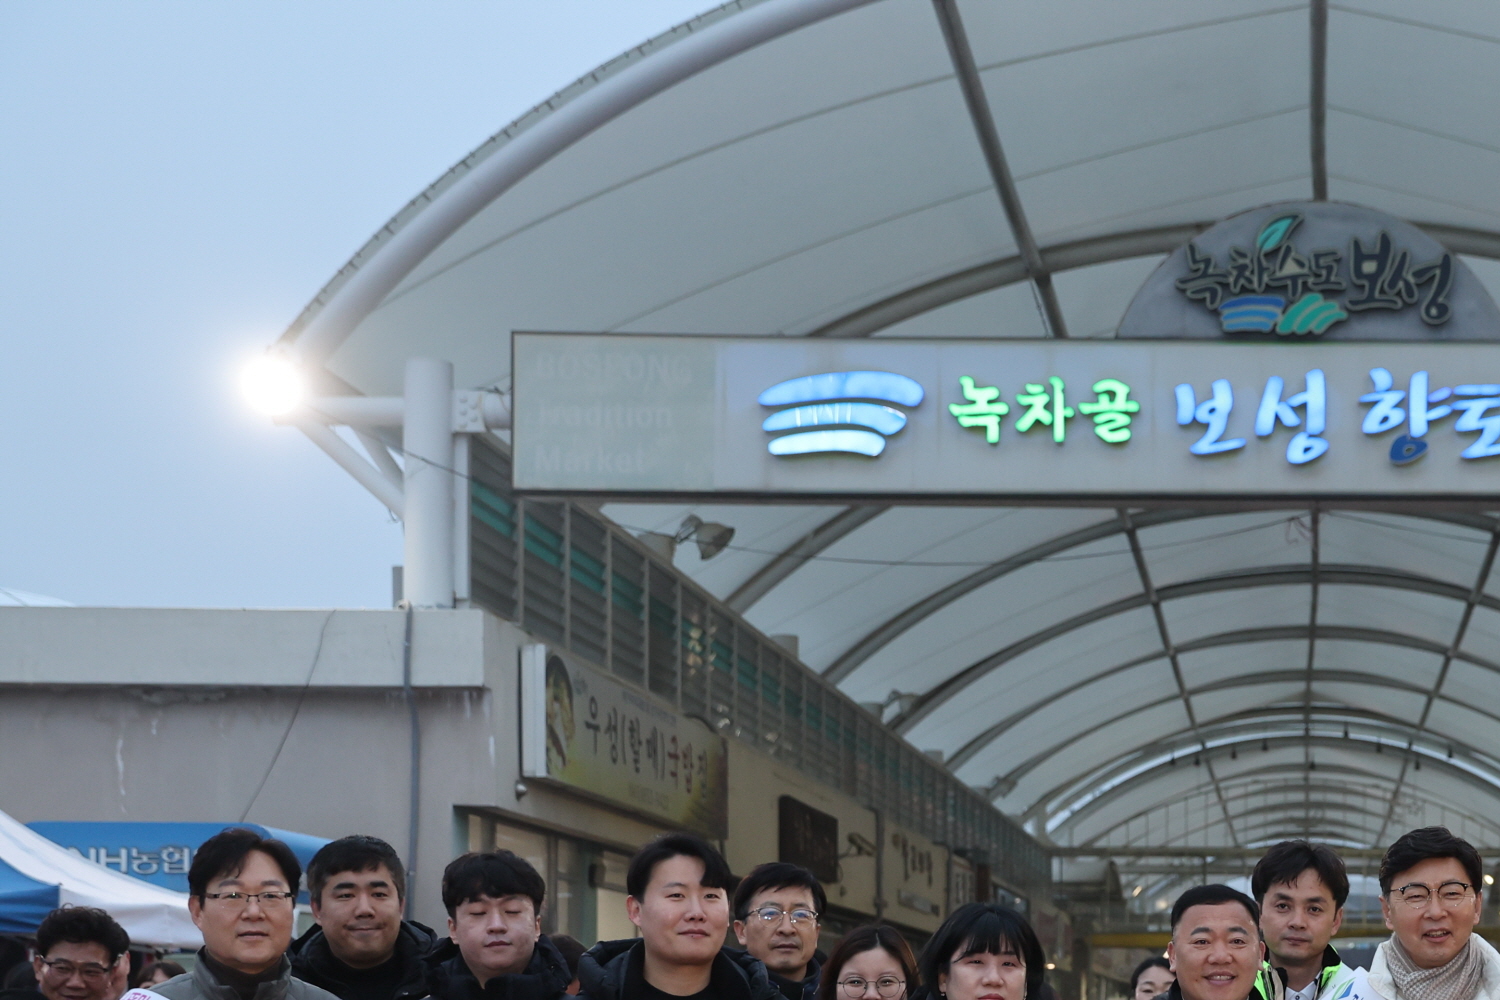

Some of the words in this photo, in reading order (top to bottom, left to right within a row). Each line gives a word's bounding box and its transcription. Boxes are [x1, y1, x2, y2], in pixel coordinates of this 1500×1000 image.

[1175, 243, 1347, 309] 녹차수도
[1345, 230, 1454, 325] 보성
[949, 375, 1142, 445] 녹차골
[1175, 369, 1331, 465] 보성
[67, 845, 197, 874] NH농협
